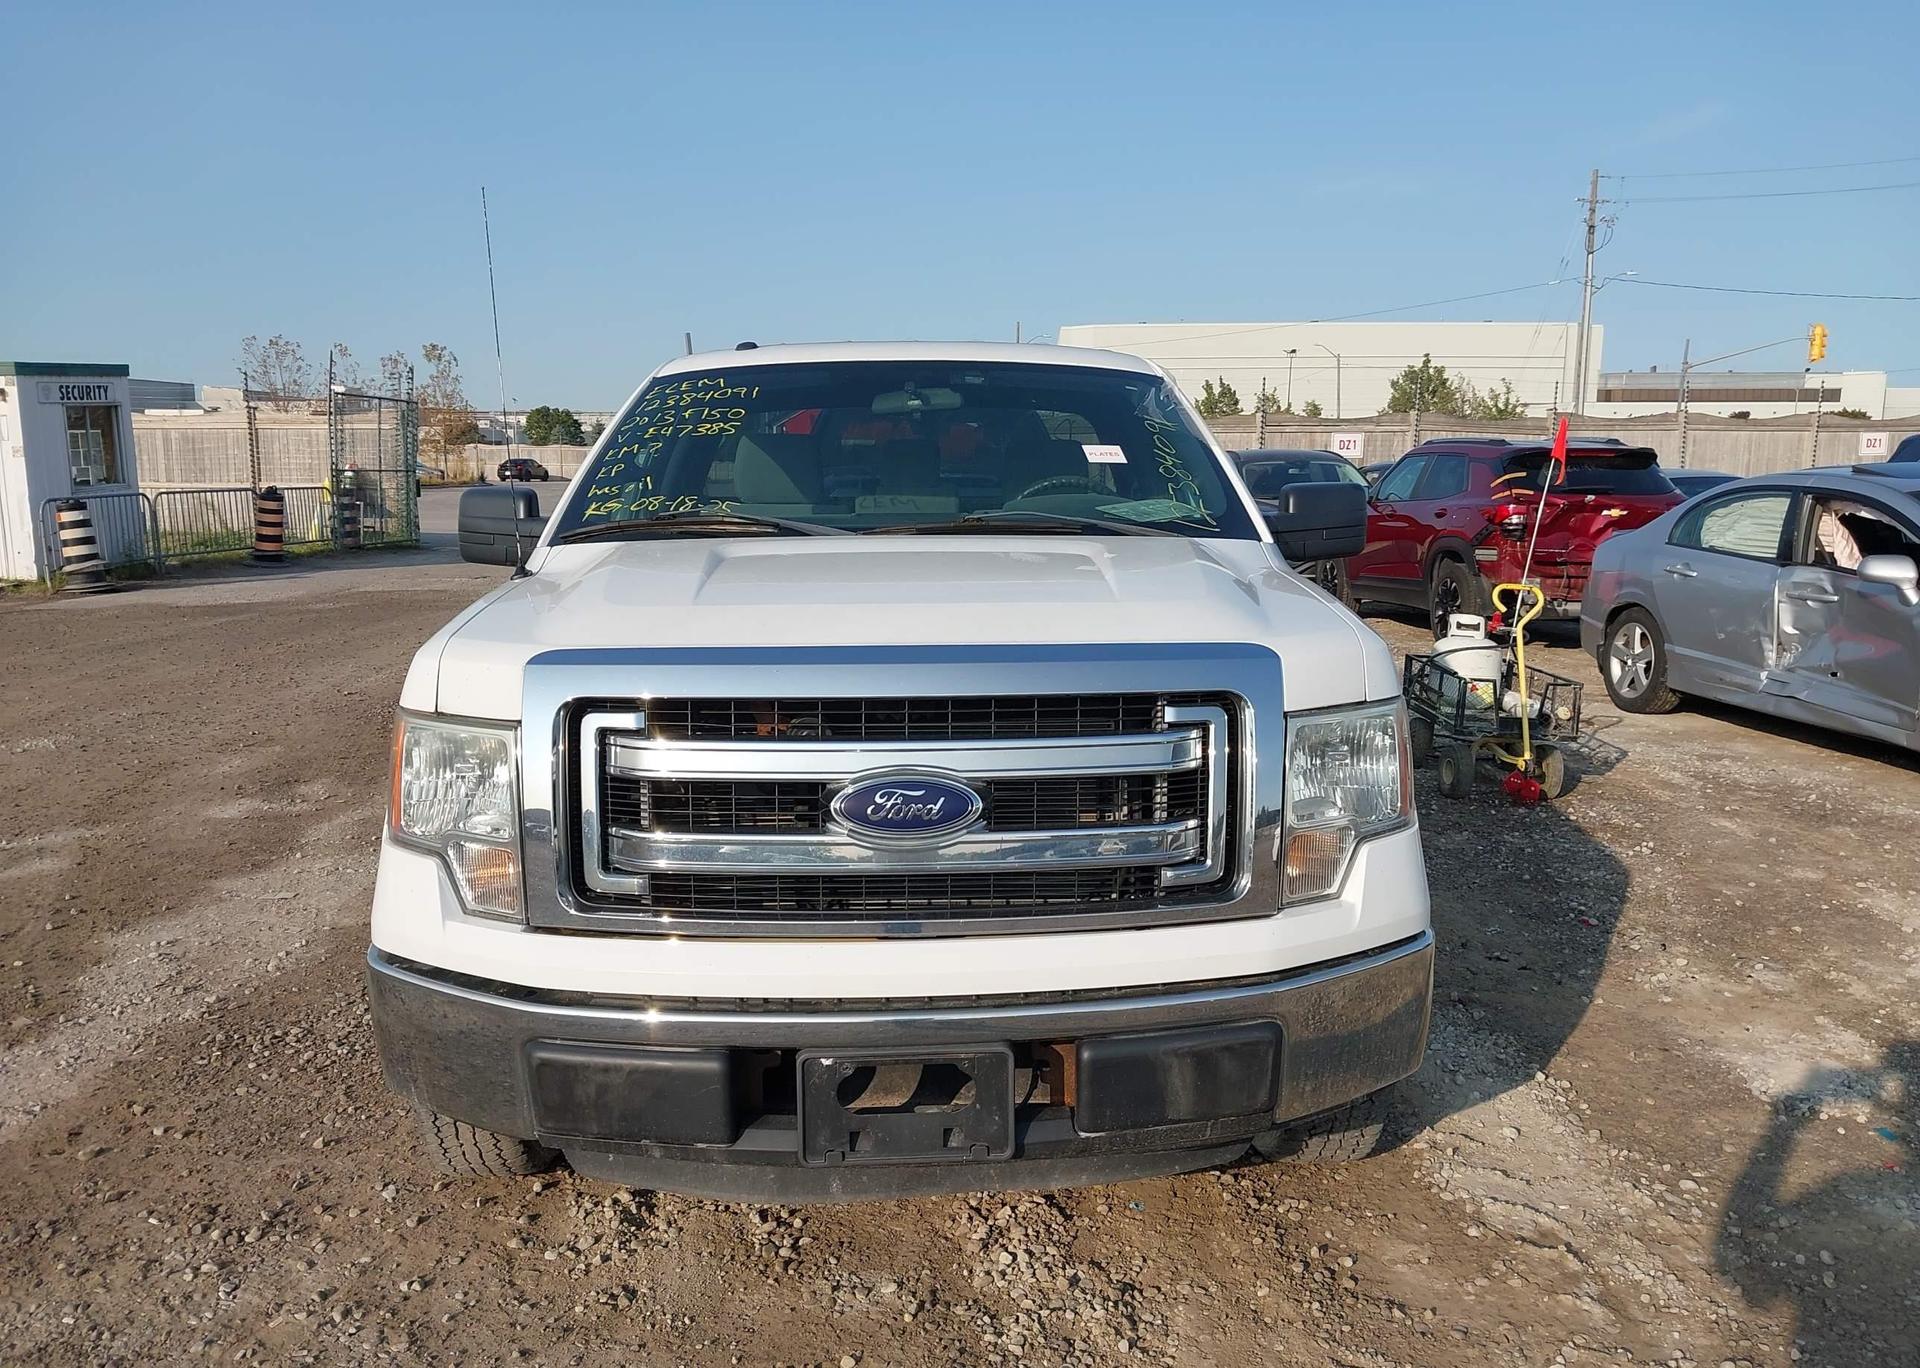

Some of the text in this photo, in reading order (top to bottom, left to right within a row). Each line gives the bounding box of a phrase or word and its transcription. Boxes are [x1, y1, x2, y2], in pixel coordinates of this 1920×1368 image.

[58, 384, 109, 401] SECURITY
[636, 386, 760, 414] 12384091
[620, 407, 746, 431] 2013 F150
[1338, 439, 1357, 450] DZ1
[1865, 438, 1882, 448] DZ1
[595, 463, 625, 480] KP
[866, 788, 946, 821] Ford
